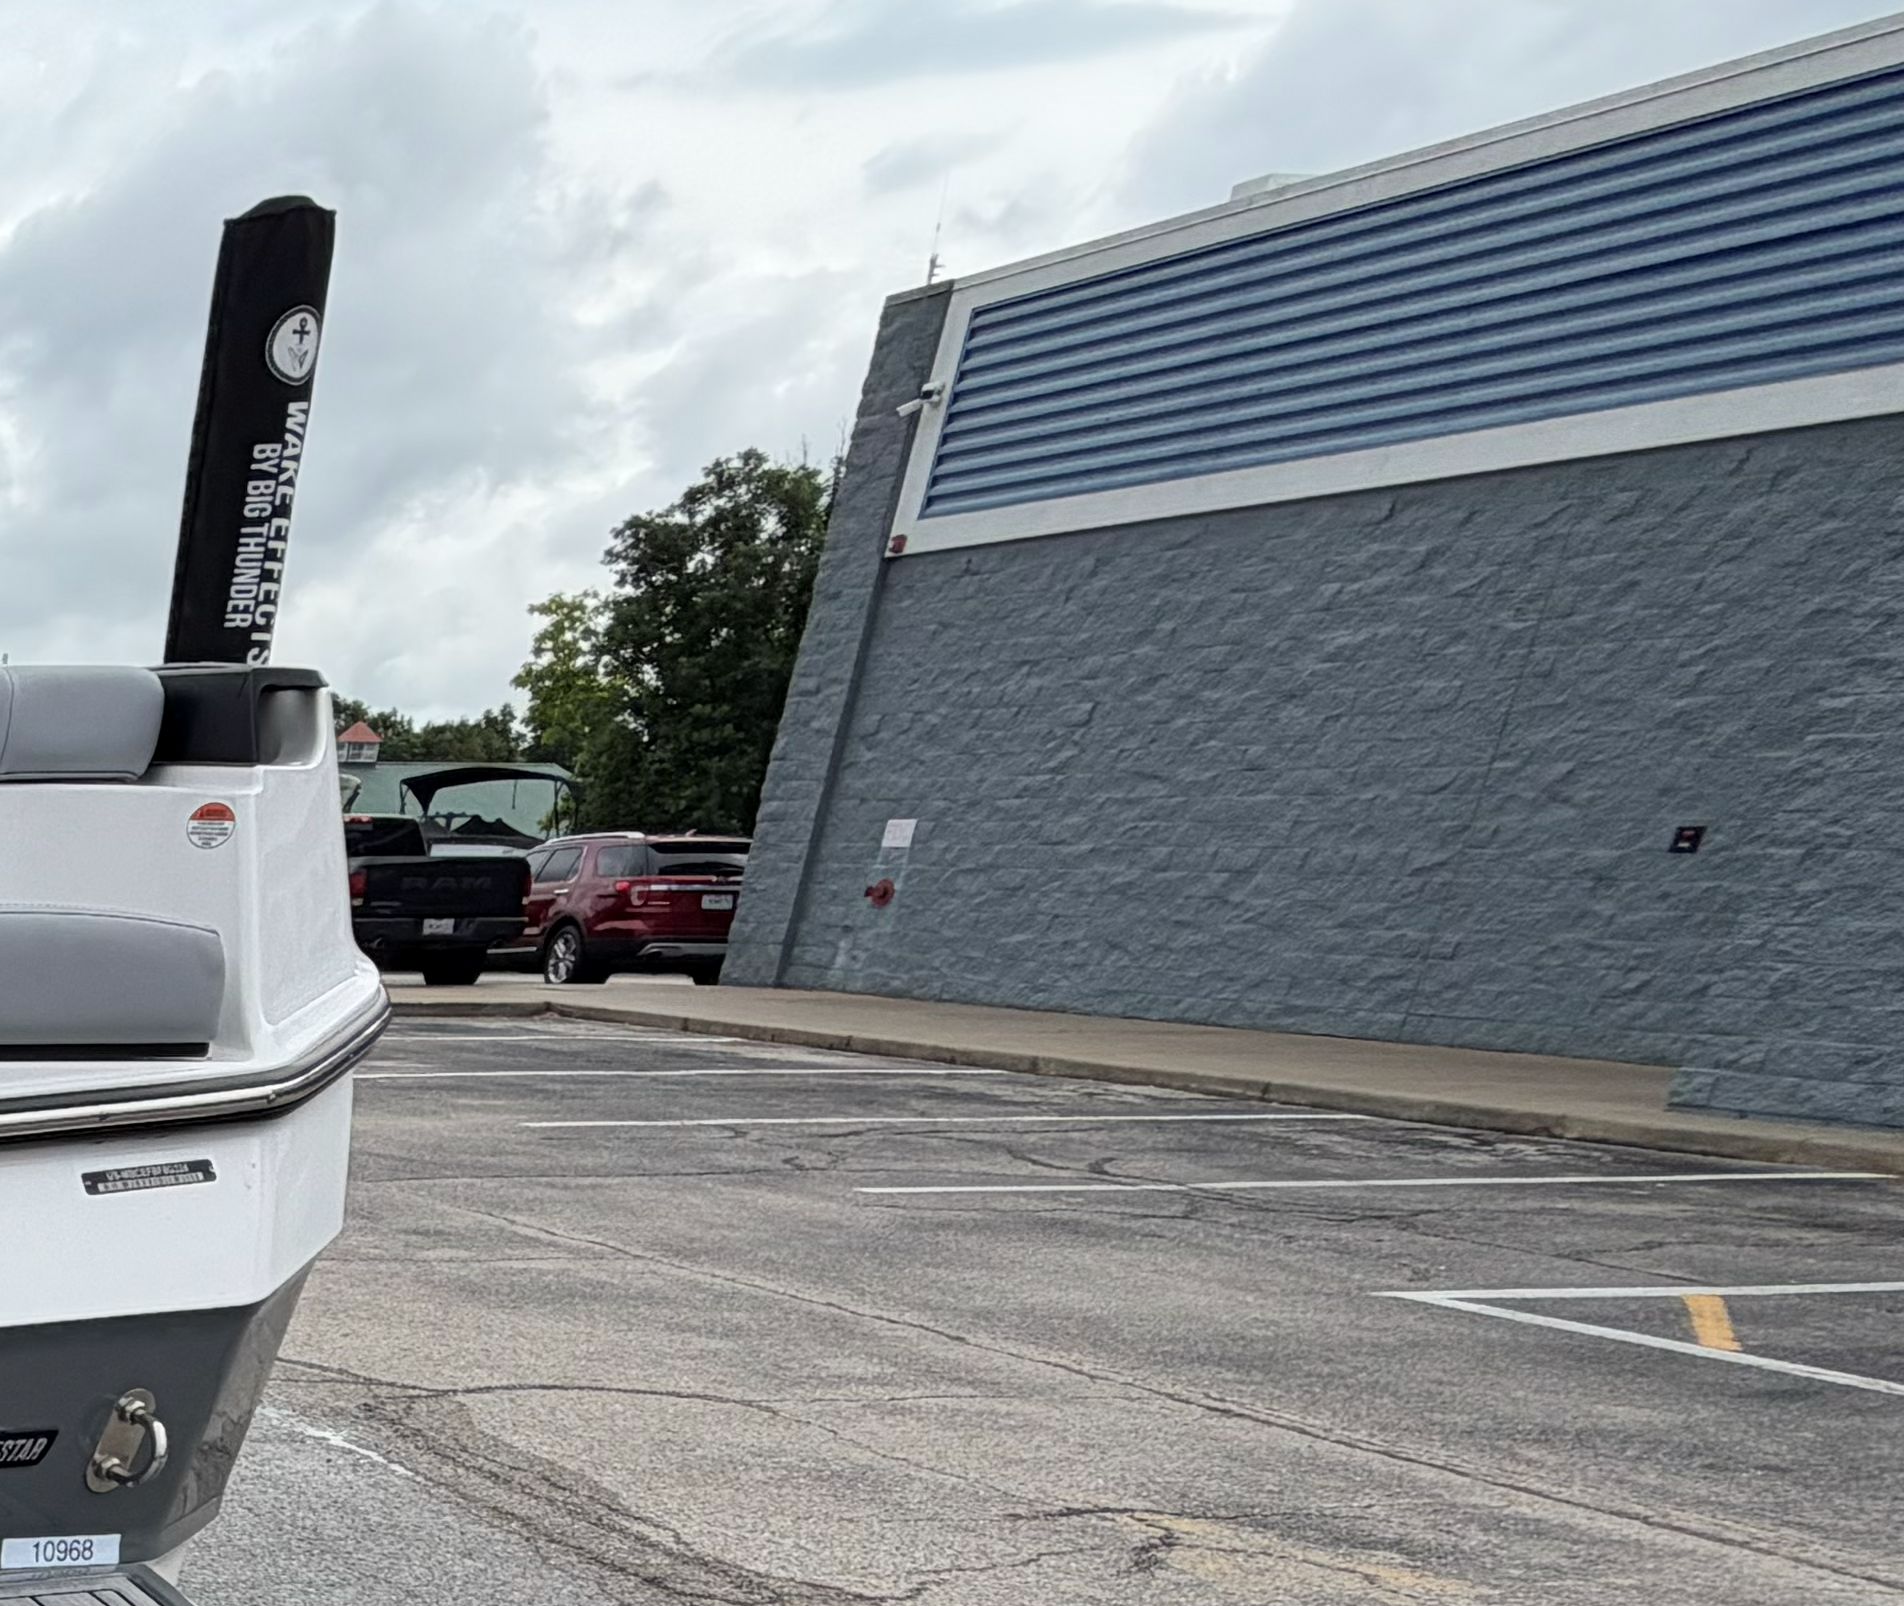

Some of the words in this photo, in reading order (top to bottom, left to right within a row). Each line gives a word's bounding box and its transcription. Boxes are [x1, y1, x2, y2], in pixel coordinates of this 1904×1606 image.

[250, 443, 282, 473] BY
[274, 401, 309, 506] WAKE
[243, 480, 276, 518] BIG
[223, 522, 270, 628] THUNDER
[32, 1538, 94, 1563] 10968
